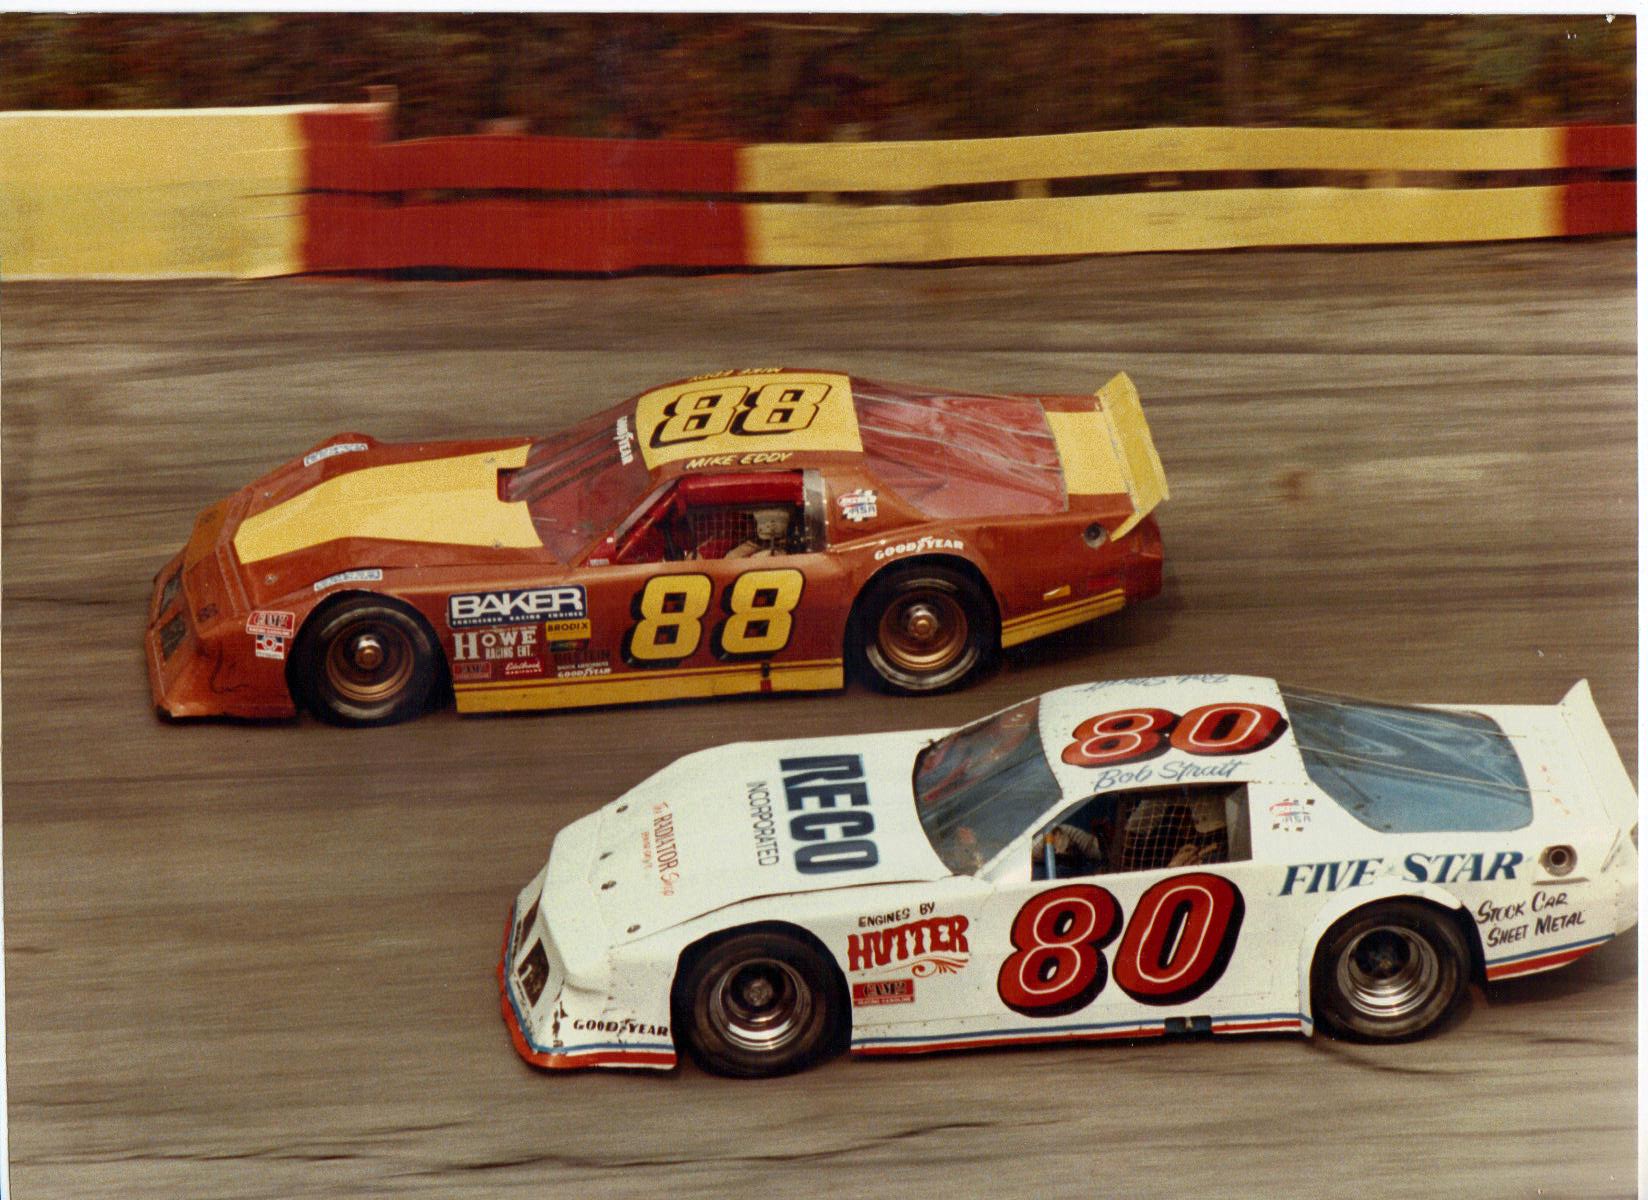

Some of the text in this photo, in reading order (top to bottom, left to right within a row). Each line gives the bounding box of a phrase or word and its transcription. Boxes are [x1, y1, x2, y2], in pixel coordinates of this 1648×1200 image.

[650, 382, 832, 448] 88
[685, 451, 793, 470] MIKE EDDY
[874, 535, 964, 561] GOODYEAR
[451, 588, 584, 619] BAKER
[623, 568, 805, 666] 88
[547, 622, 588, 633] BRODIX
[452, 629, 538, 660] HOWE
[485, 646, 514, 660] RACING
[557, 667, 612, 679] GOODYEAR
[1061, 703, 1289, 769] 80
[1093, 759, 1250, 792] Bob Strait
[746, 781, 780, 867] INCORPORATED
[779, 753, 879, 875] RECO
[653, 812, 680, 873] RADIATOR
[1279, 851, 1525, 896] FIVE STAR
[858, 902, 935, 928] ENGINES BY
[847, 915, 969, 972] HUTTER
[997, 872, 1245, 1018] 80
[572, 1017, 669, 1037] GOODYEAR
